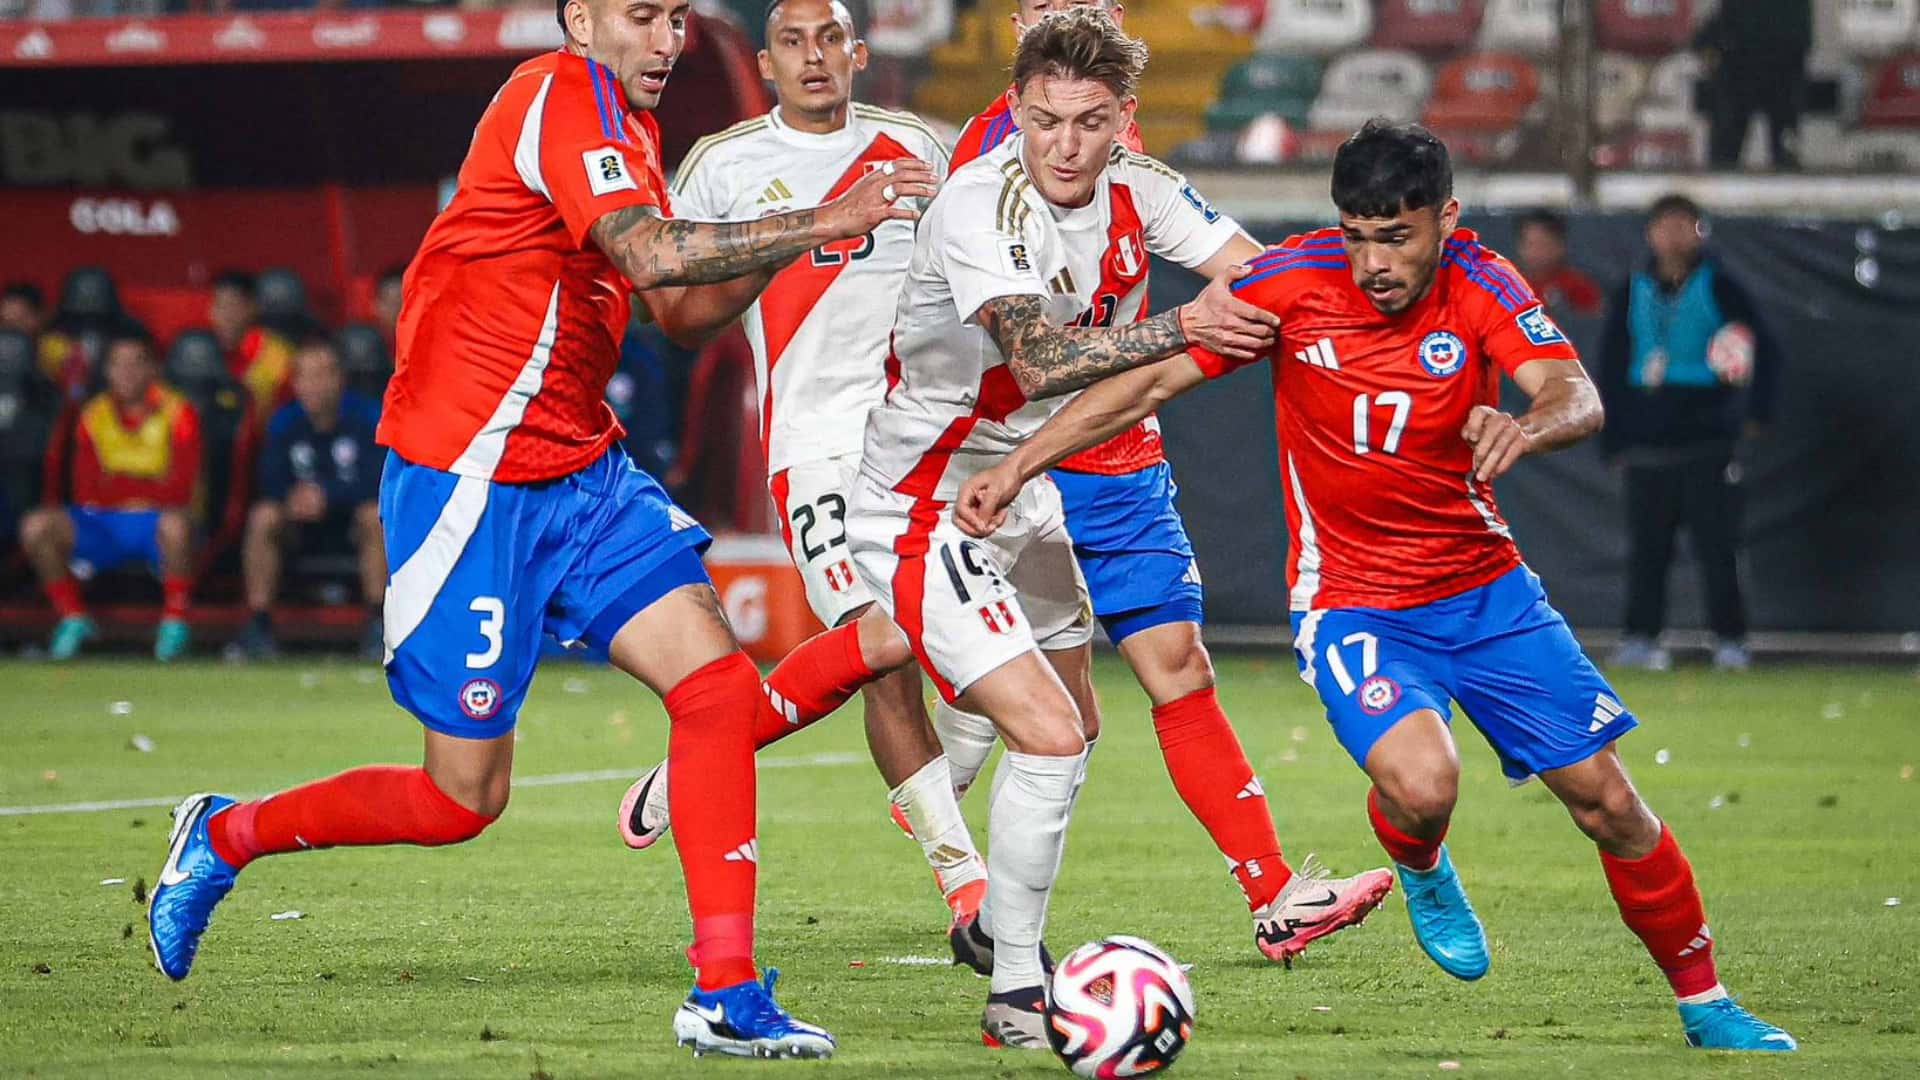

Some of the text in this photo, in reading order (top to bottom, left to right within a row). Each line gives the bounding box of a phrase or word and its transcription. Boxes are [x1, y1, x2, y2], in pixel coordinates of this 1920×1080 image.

[69, 199, 180, 236] COLA
[1353, 390, 1412, 455] 17
[792, 493, 846, 563] 23
[466, 596, 504, 668] 3
[1326, 632, 1377, 696] 17
